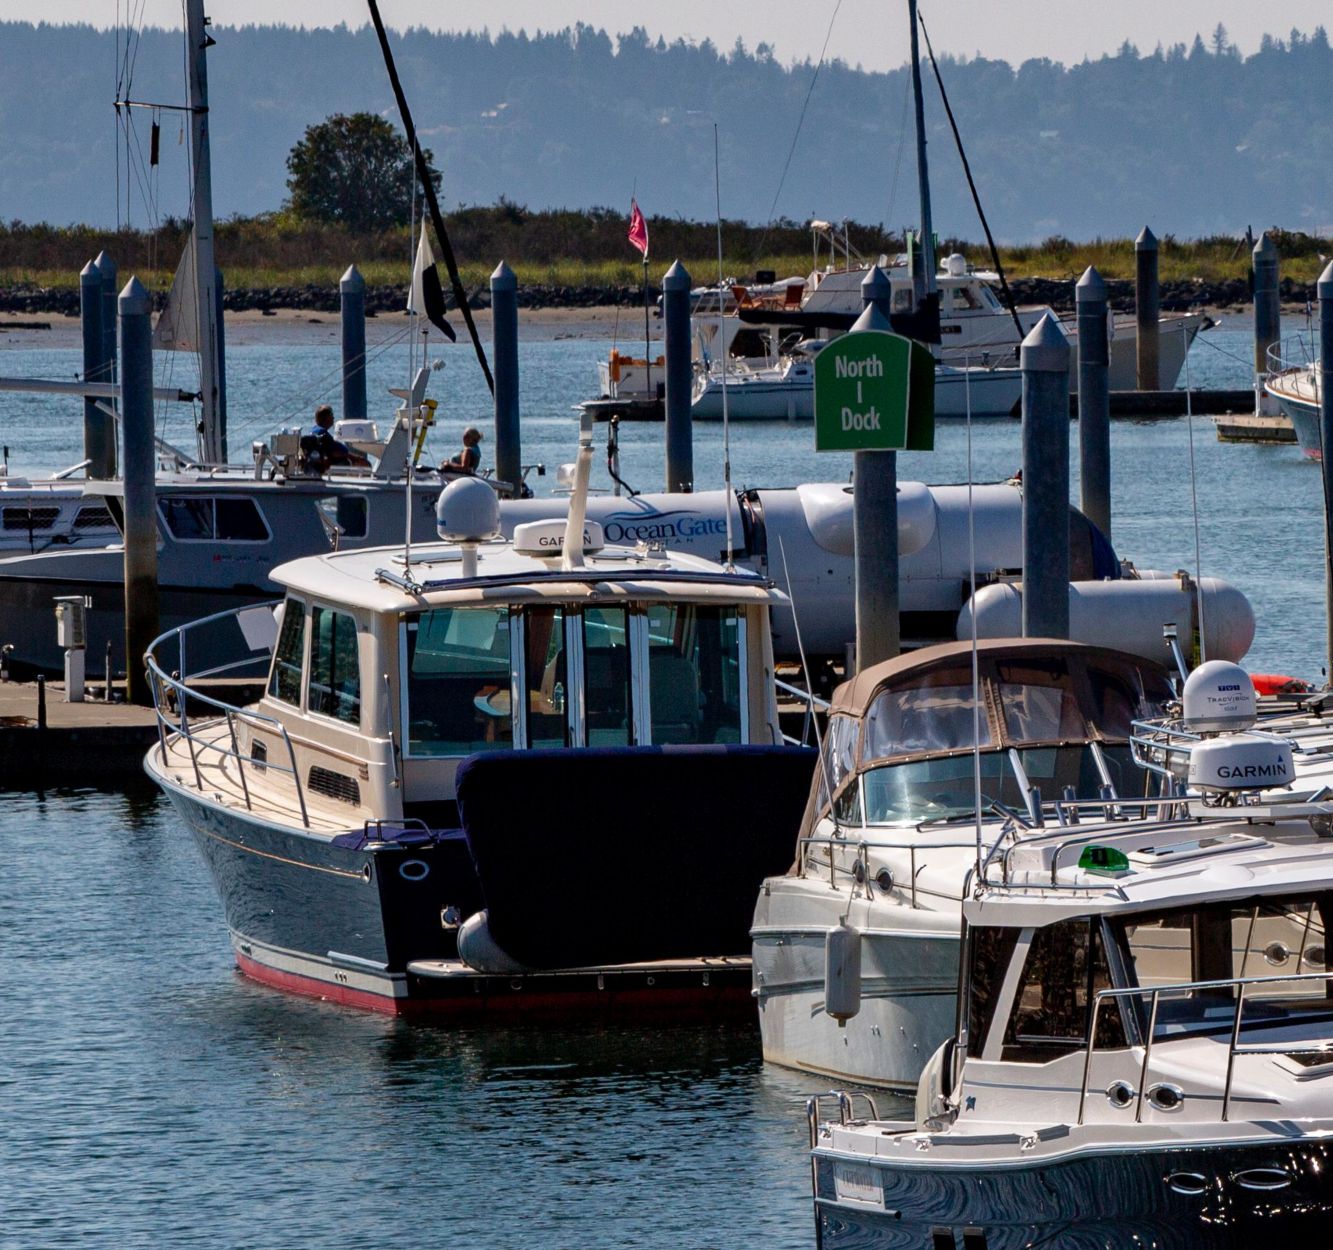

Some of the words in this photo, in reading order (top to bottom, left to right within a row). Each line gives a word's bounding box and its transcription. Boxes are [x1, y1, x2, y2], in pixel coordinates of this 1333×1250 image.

[835, 354, 883, 378] North
[841, 406, 881, 431] Dock
[539, 535, 592, 546] GARN
[604, 517, 728, 542] OceanGate
[1217, 764, 1287, 778] GARMIN
